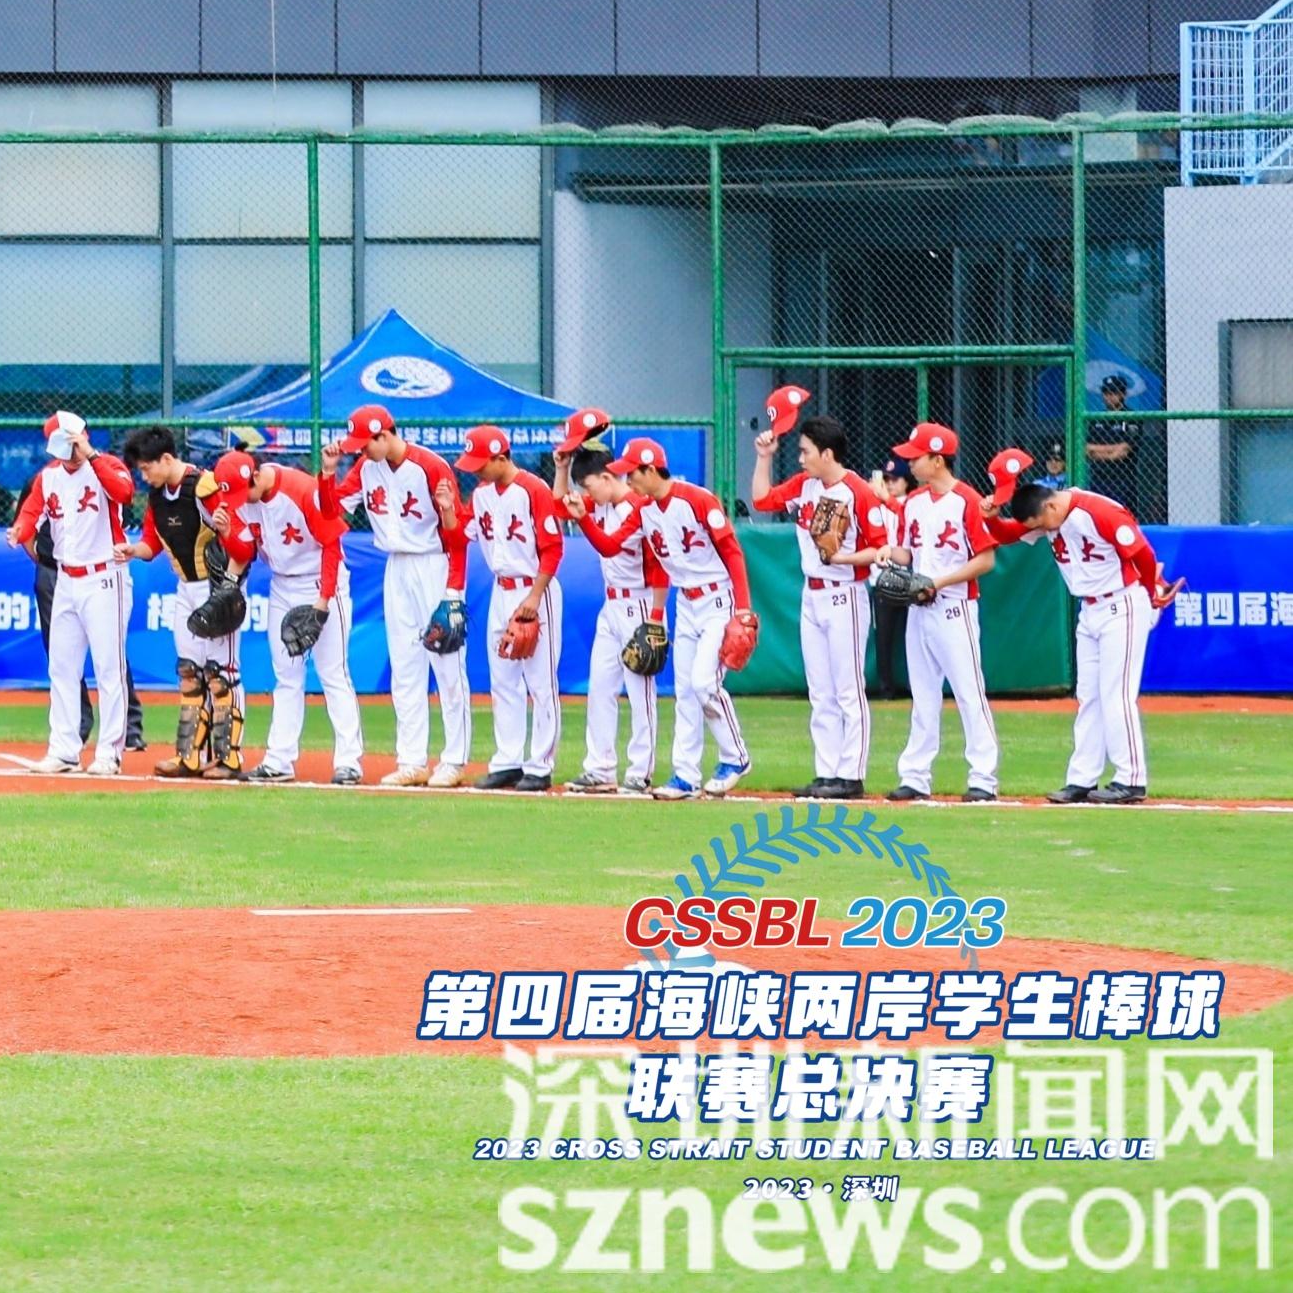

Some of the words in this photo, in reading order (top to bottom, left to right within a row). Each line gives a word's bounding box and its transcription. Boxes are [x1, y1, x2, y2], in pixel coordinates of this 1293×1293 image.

[831, 594, 848, 607] 23
[1175, 592, 1293, 626] 第四届海
